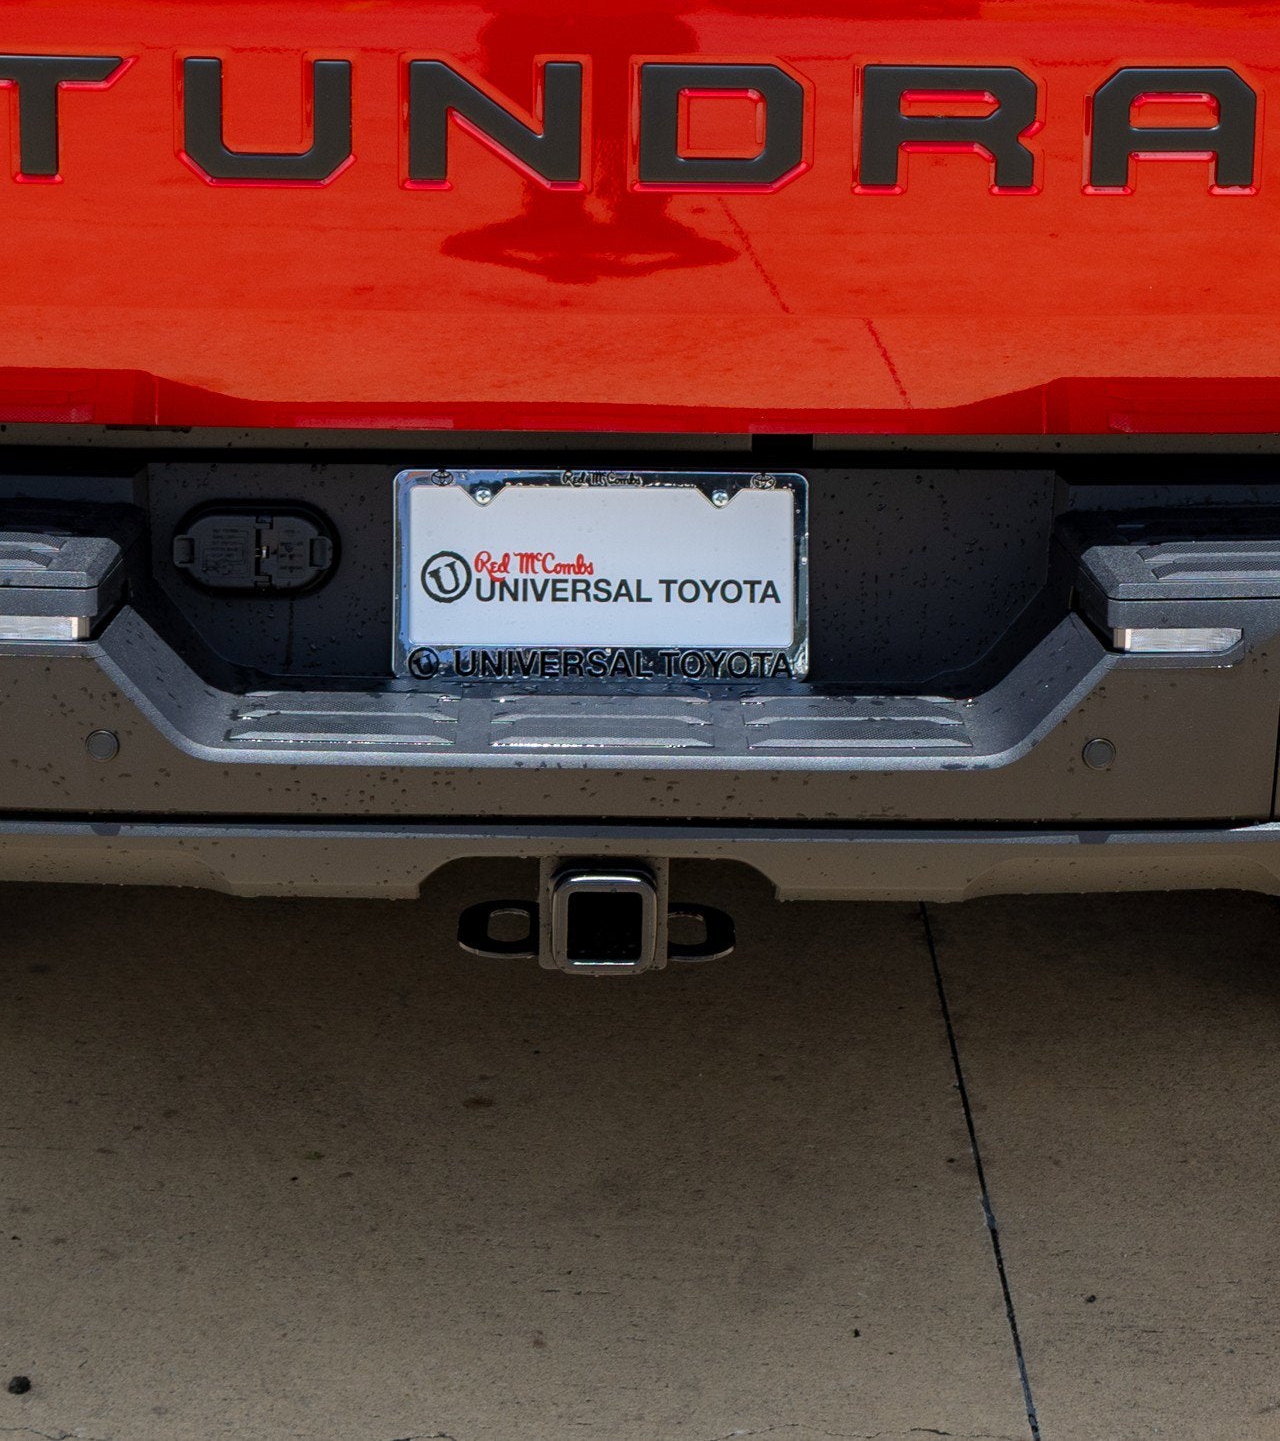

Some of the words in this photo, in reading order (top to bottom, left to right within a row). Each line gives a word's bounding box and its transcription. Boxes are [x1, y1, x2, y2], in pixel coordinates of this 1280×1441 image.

[474, 550, 510, 582] Red
[513, 552, 594, 575] McCombs
[475, 578, 652, 603] UNIVERSAL
[659, 579, 781, 603] TOYOTA
[453, 649, 654, 678] UNIVERSAL
[658, 649, 795, 679] TOYOTA
